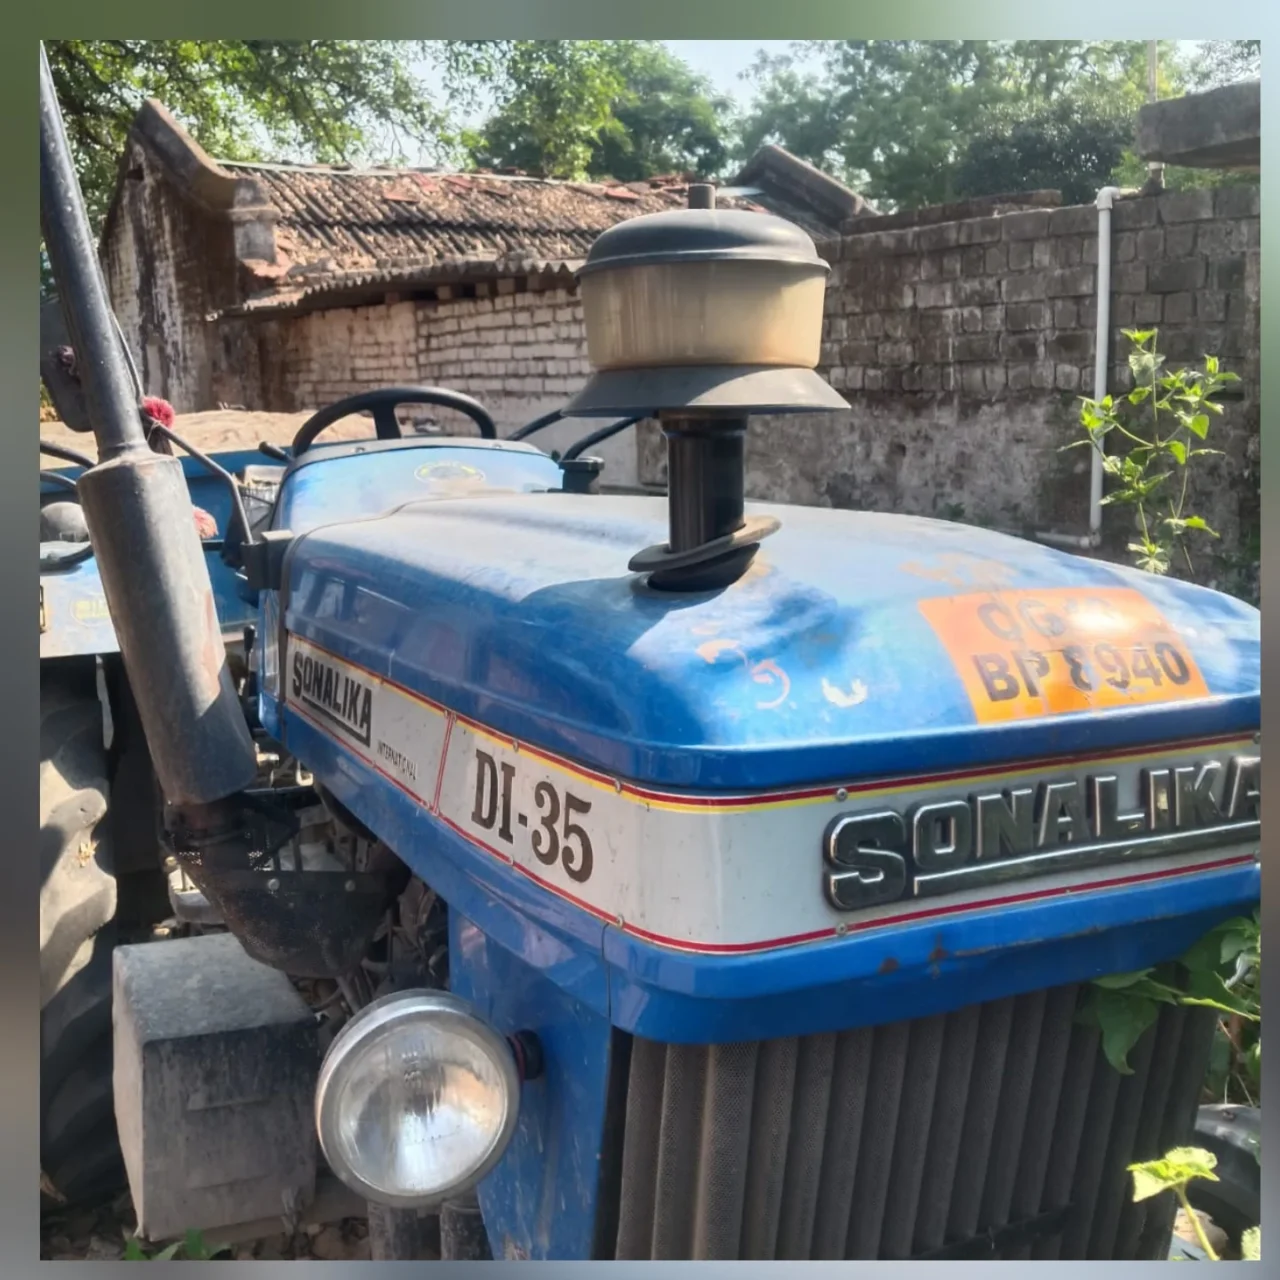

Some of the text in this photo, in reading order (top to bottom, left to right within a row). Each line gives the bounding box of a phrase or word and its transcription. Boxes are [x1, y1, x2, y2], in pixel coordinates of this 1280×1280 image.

[292, 651, 373, 730] SONALIKA
[973, 651, 1049, 701] BP
[471, 748, 594, 884] DI-35
[823, 755, 1260, 912] SONALIKA
